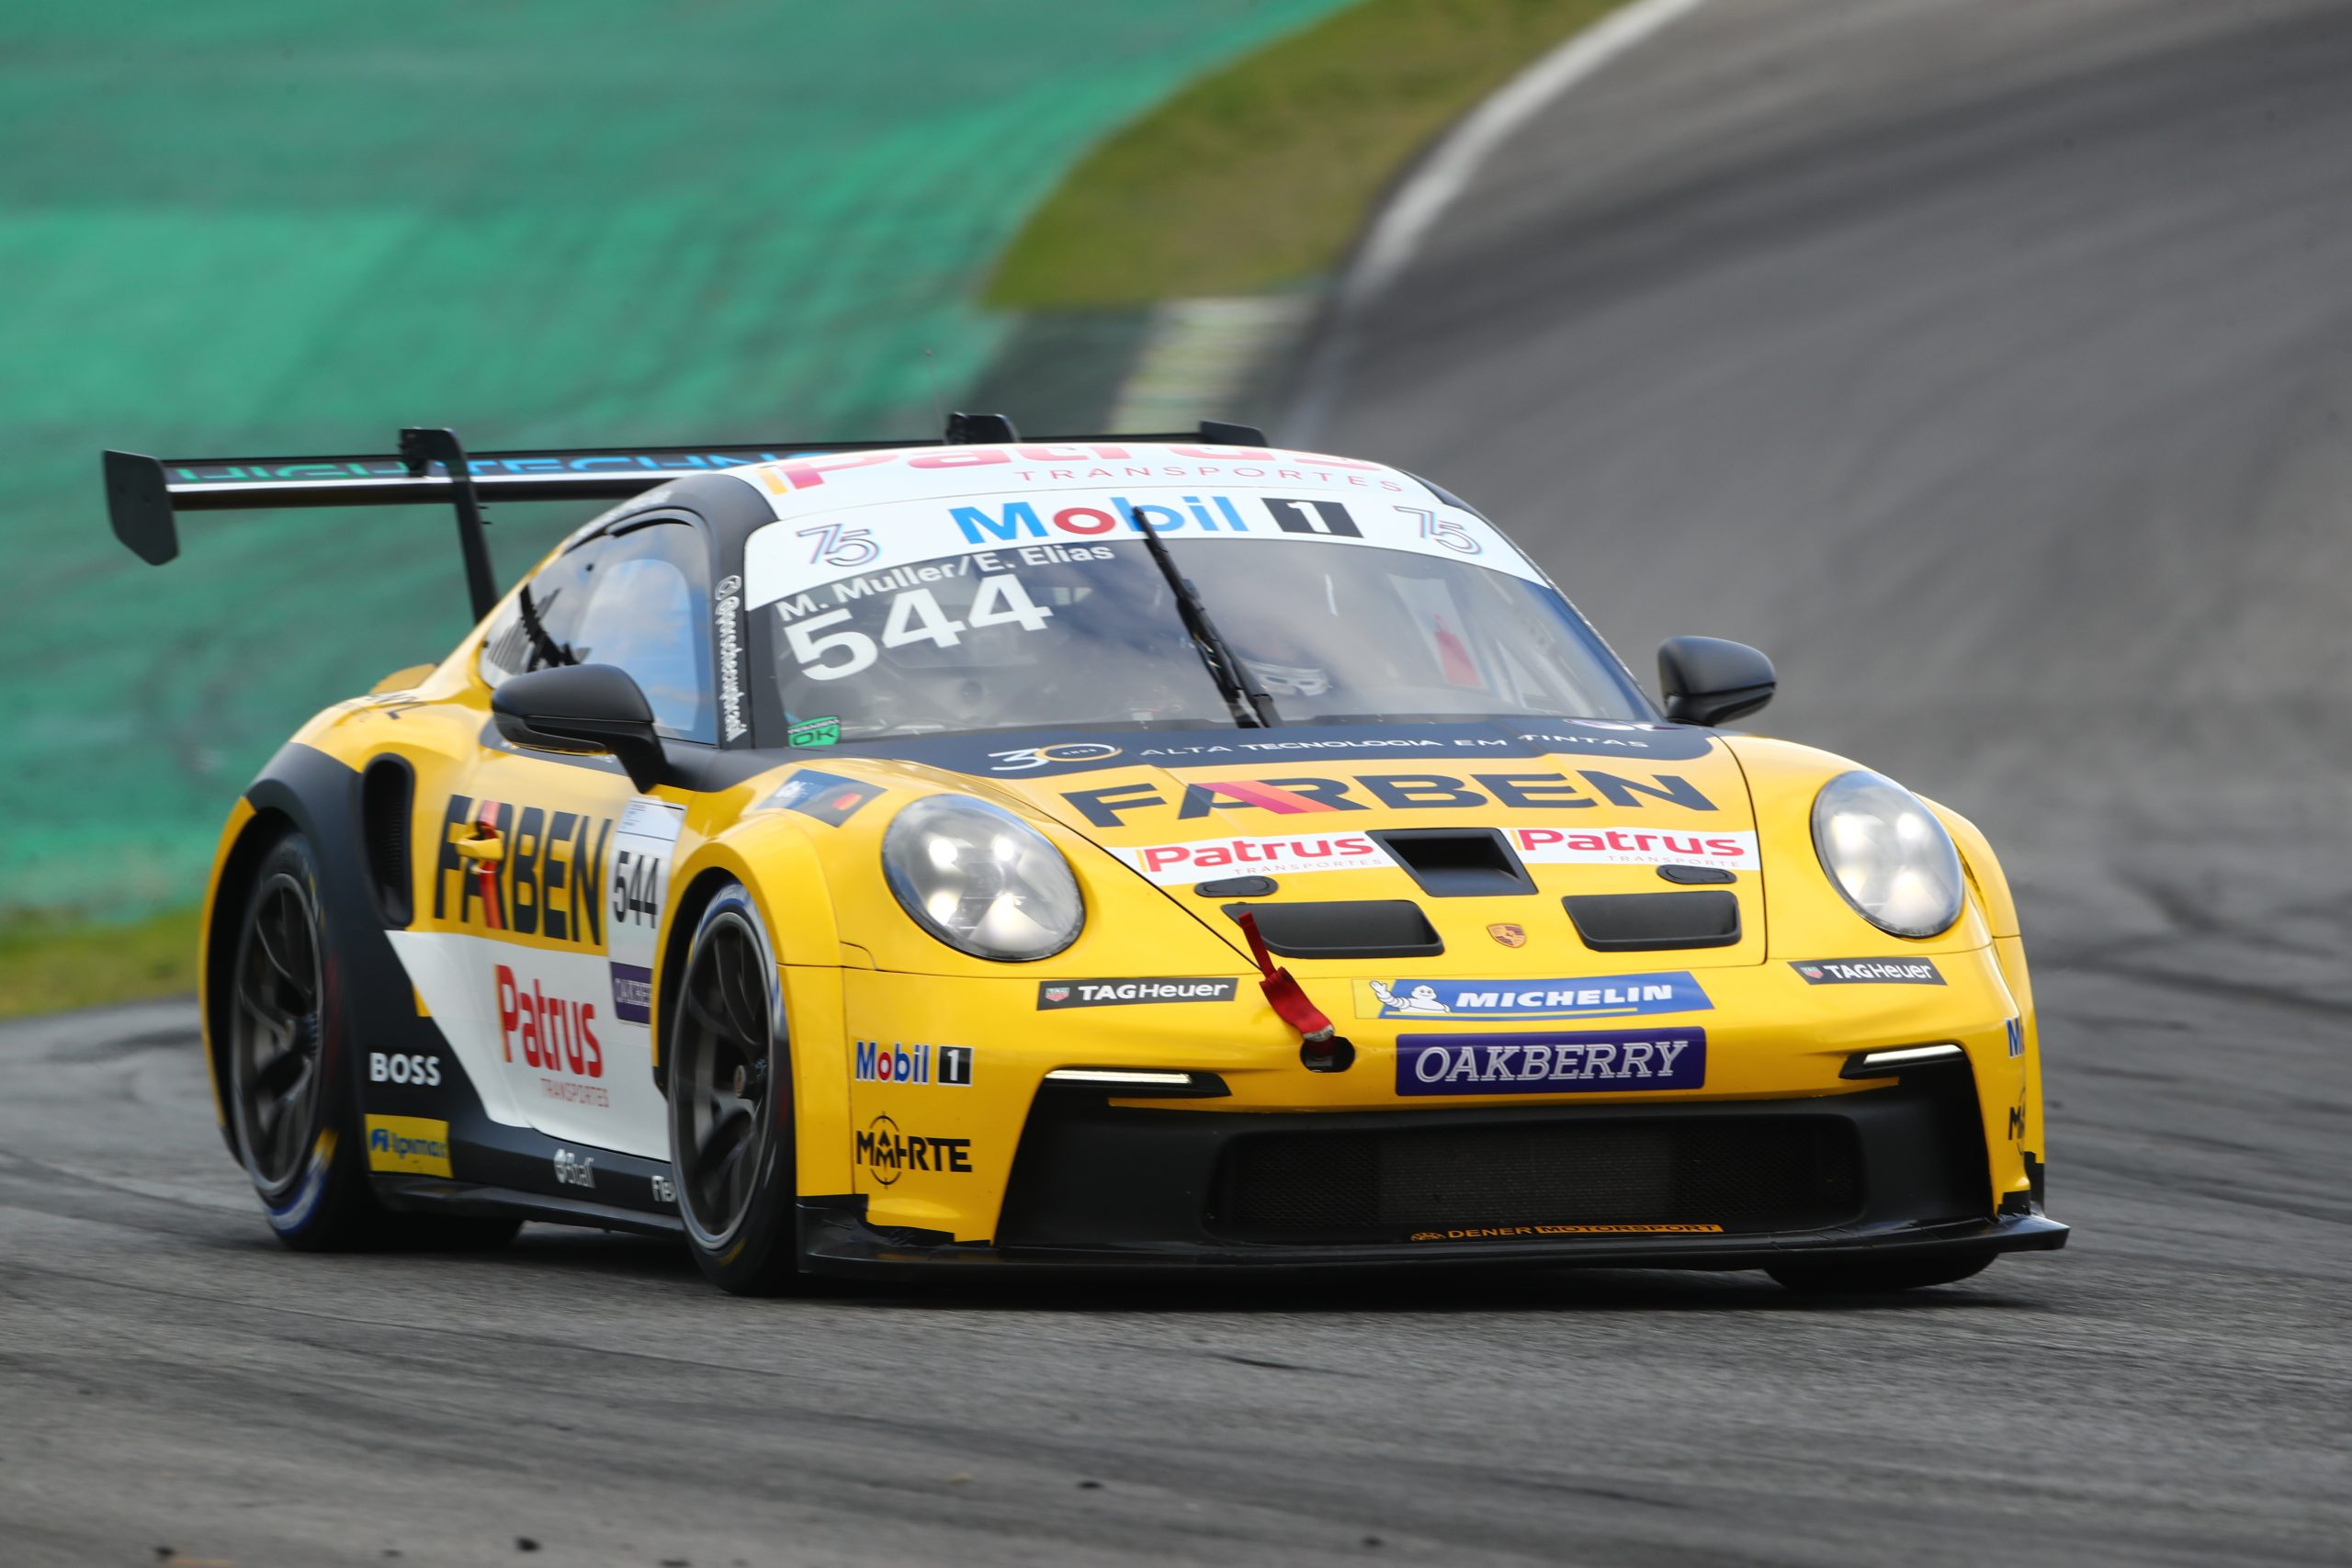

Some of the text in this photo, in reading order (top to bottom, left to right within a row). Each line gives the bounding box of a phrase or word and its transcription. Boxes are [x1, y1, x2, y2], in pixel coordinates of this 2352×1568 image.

[1015, 466, 1403, 492] TRANSPORTES
[948, 496, 1250, 544] Mobil
[1393, 505, 1483, 555] 75
[797, 522, 879, 568] 75
[776, 592, 828, 622] M.
[1018, 543, 1115, 566] Elias
[783, 573, 1055, 681] 544
[793, 726, 835, 746] OK
[1139, 733, 1649, 756] ALTA TECNOLOGIA EM TINTAS
[1059, 770, 1721, 828] FARBEN
[1143, 837, 1375, 873] Patrus
[1518, 829, 1746, 857] Patrus
[435, 794, 613, 946] FARBEN
[1234, 859, 1383, 875] TRANSPORTES
[612, 851, 660, 930] 544
[1455, 984, 1672, 1009] MICHELIN
[496, 964, 605, 1078] Patrus
[369, 1052, 442, 1087] BOSS
[855, 1041, 931, 1084] Mobil
[1415, 1041, 1689, 1083] OAKBERRY
[1446, 1224, 1717, 1239] DENER MOTORSPORT
